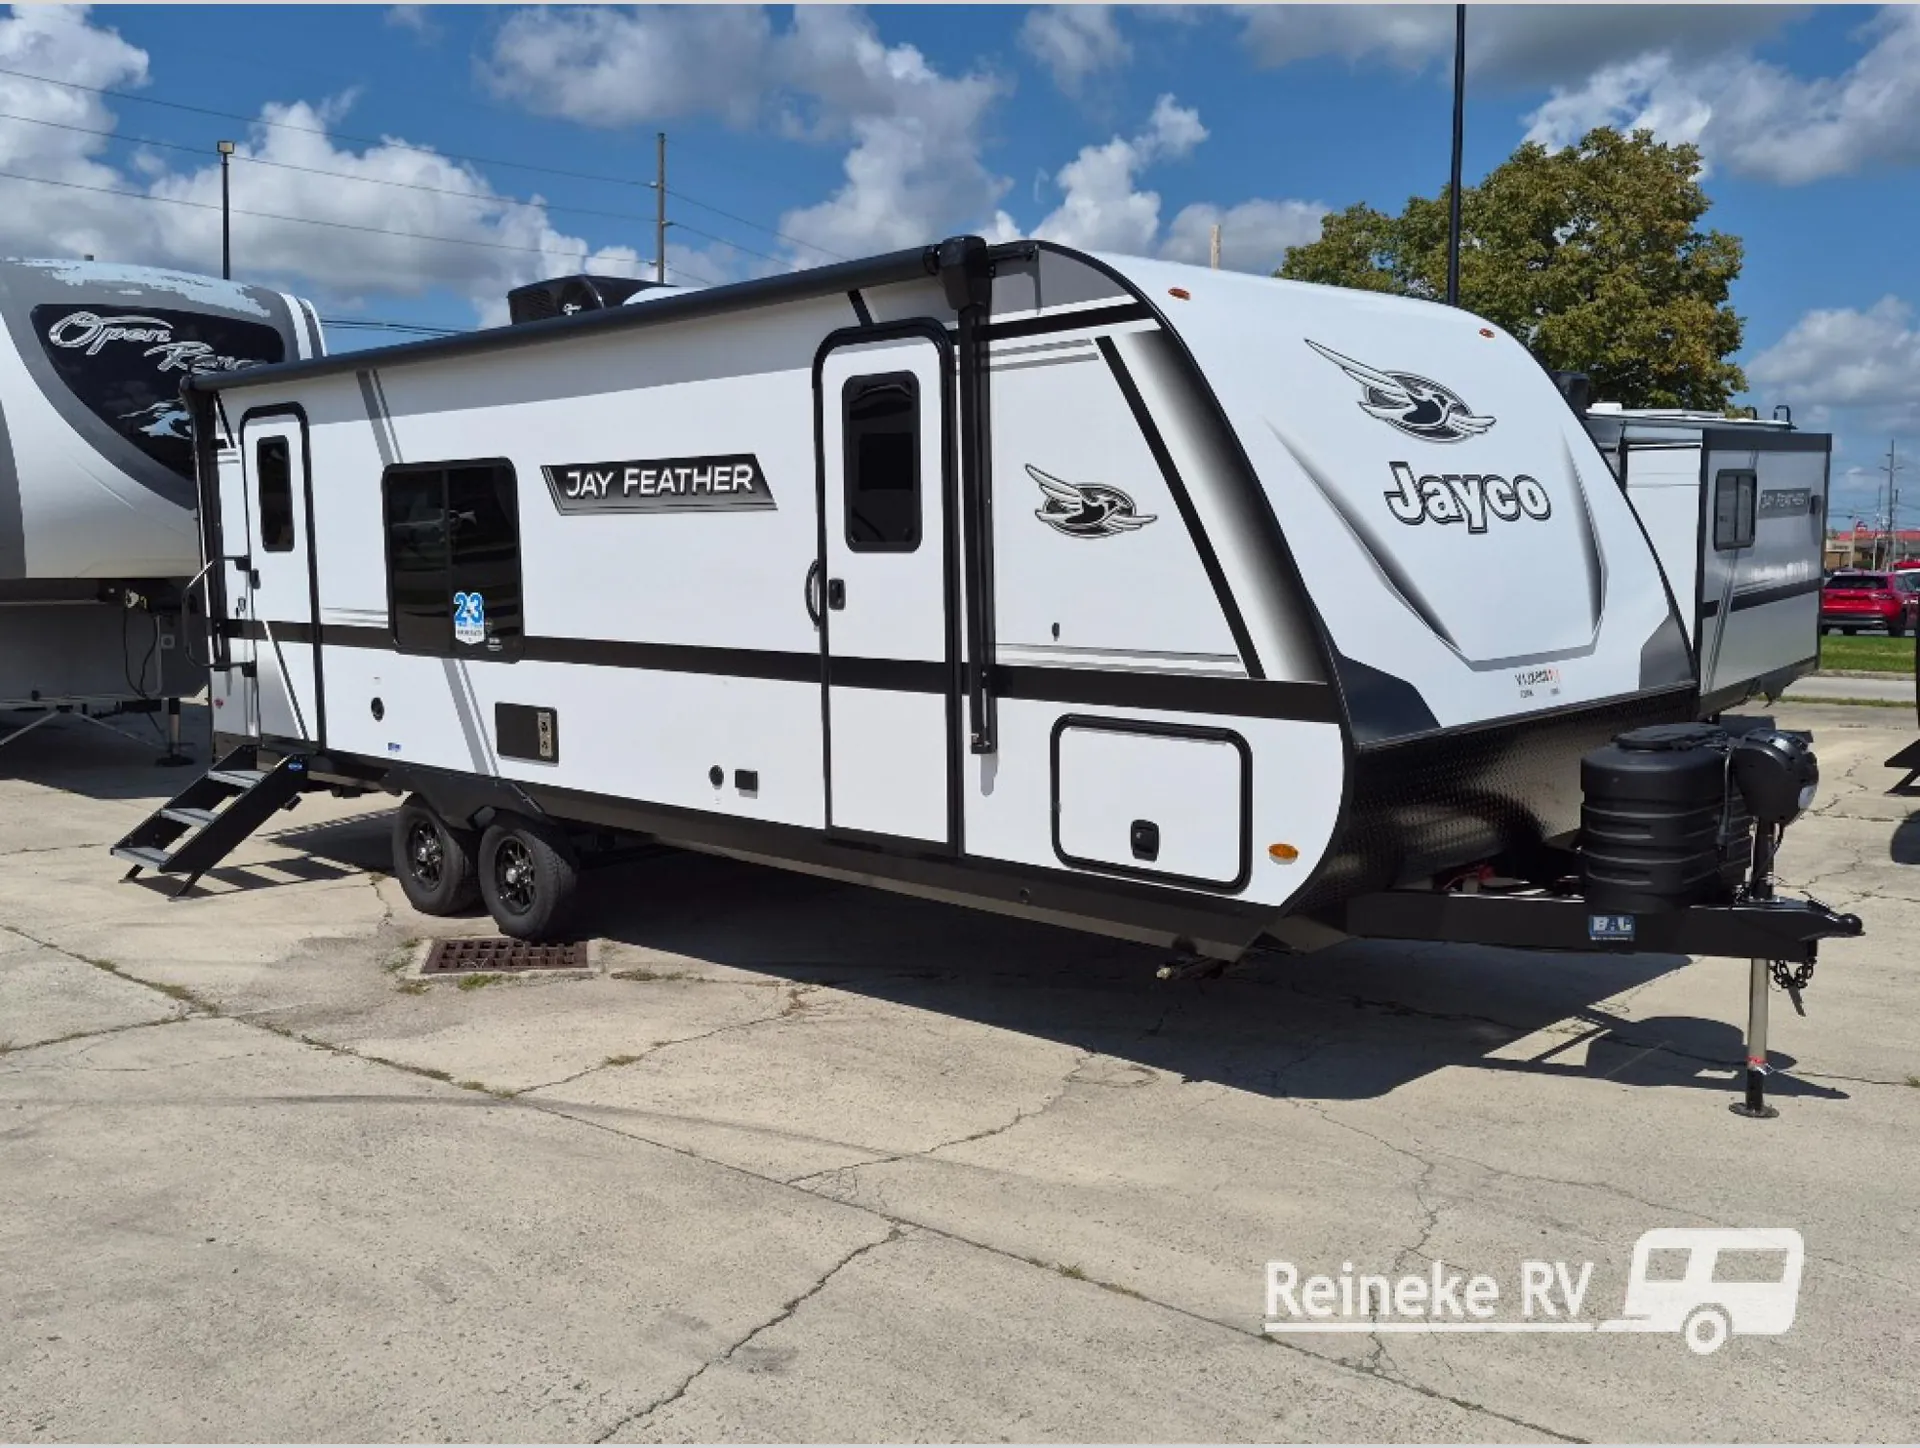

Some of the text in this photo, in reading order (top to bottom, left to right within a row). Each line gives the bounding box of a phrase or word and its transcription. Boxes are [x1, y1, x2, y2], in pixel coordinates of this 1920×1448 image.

[49, 311, 174, 355] Open
[565, 463, 755, 499] JAY FEATHER
[1384, 461, 1552, 534] Jayco
[453, 591, 484, 624] 23
